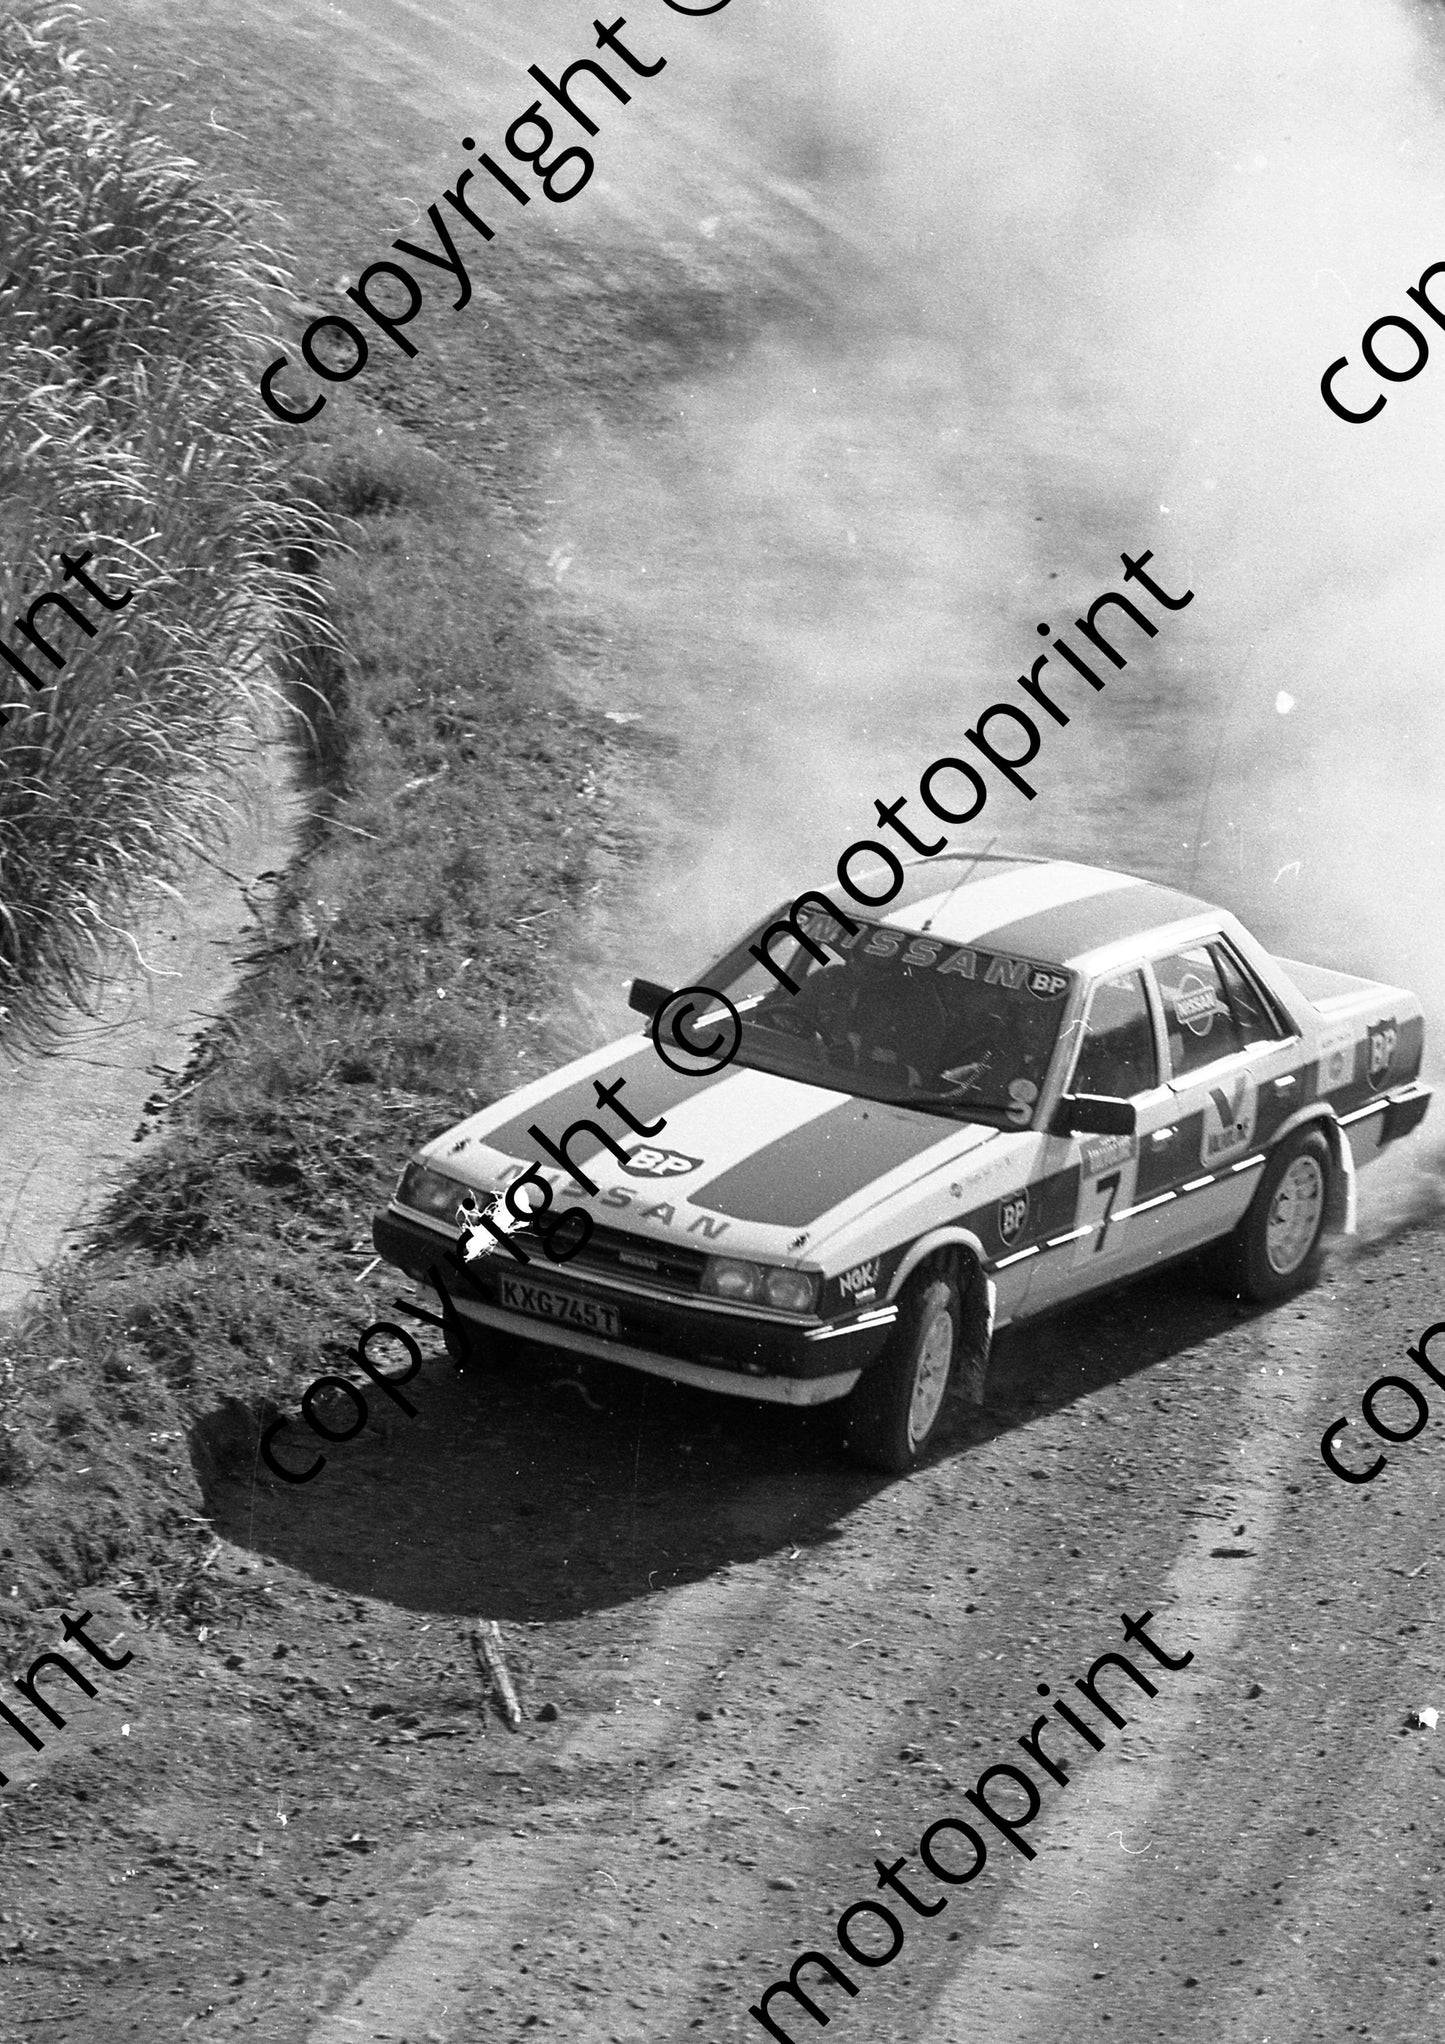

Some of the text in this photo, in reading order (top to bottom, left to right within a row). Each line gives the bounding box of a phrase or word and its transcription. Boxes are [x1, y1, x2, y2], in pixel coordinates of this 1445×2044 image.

[1033, 973, 1066, 993] BP
[1371, 1028, 1397, 1073] BP
[630, 1148, 693, 1175] BP
[1003, 1200, 1026, 1234] BP
[1097, 1171, 1121, 1252] 7
